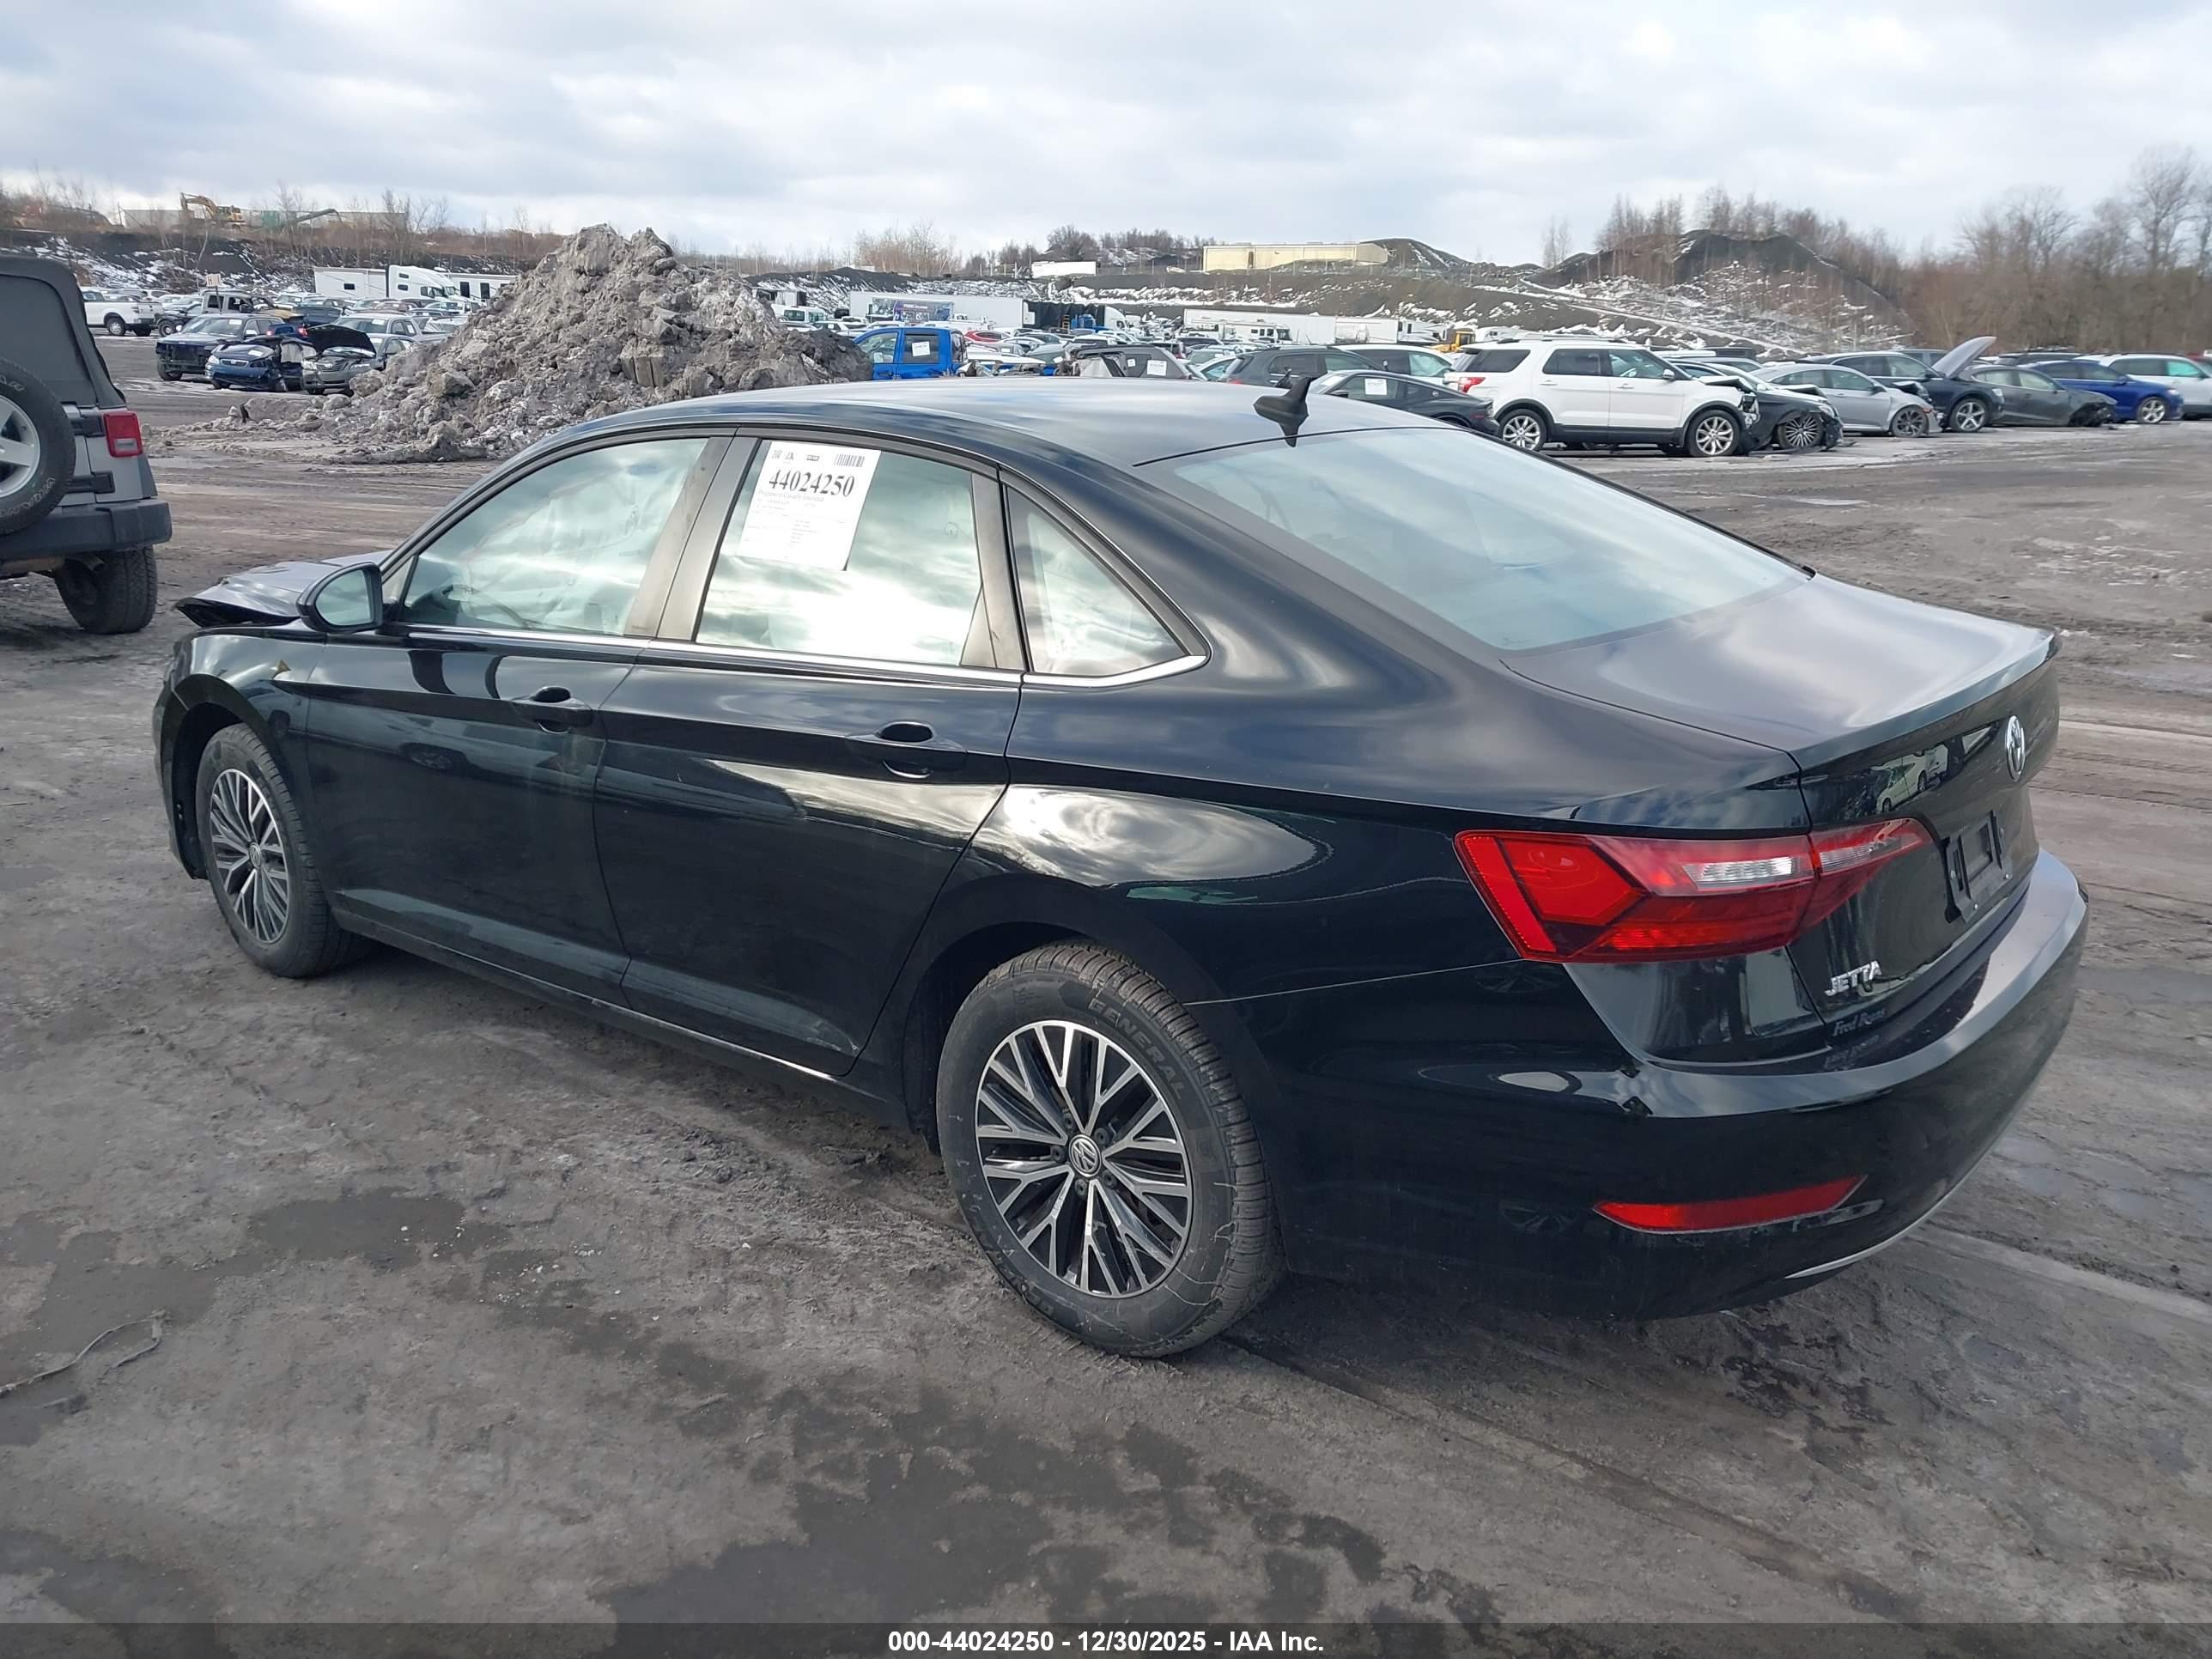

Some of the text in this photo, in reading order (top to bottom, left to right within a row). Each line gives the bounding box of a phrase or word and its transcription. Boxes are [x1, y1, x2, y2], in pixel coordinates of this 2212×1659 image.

[769, 470, 855, 496] 44024250
[1825, 960, 1882, 996] JETTA
[1088, 998, 1187, 1100] GENERAL
